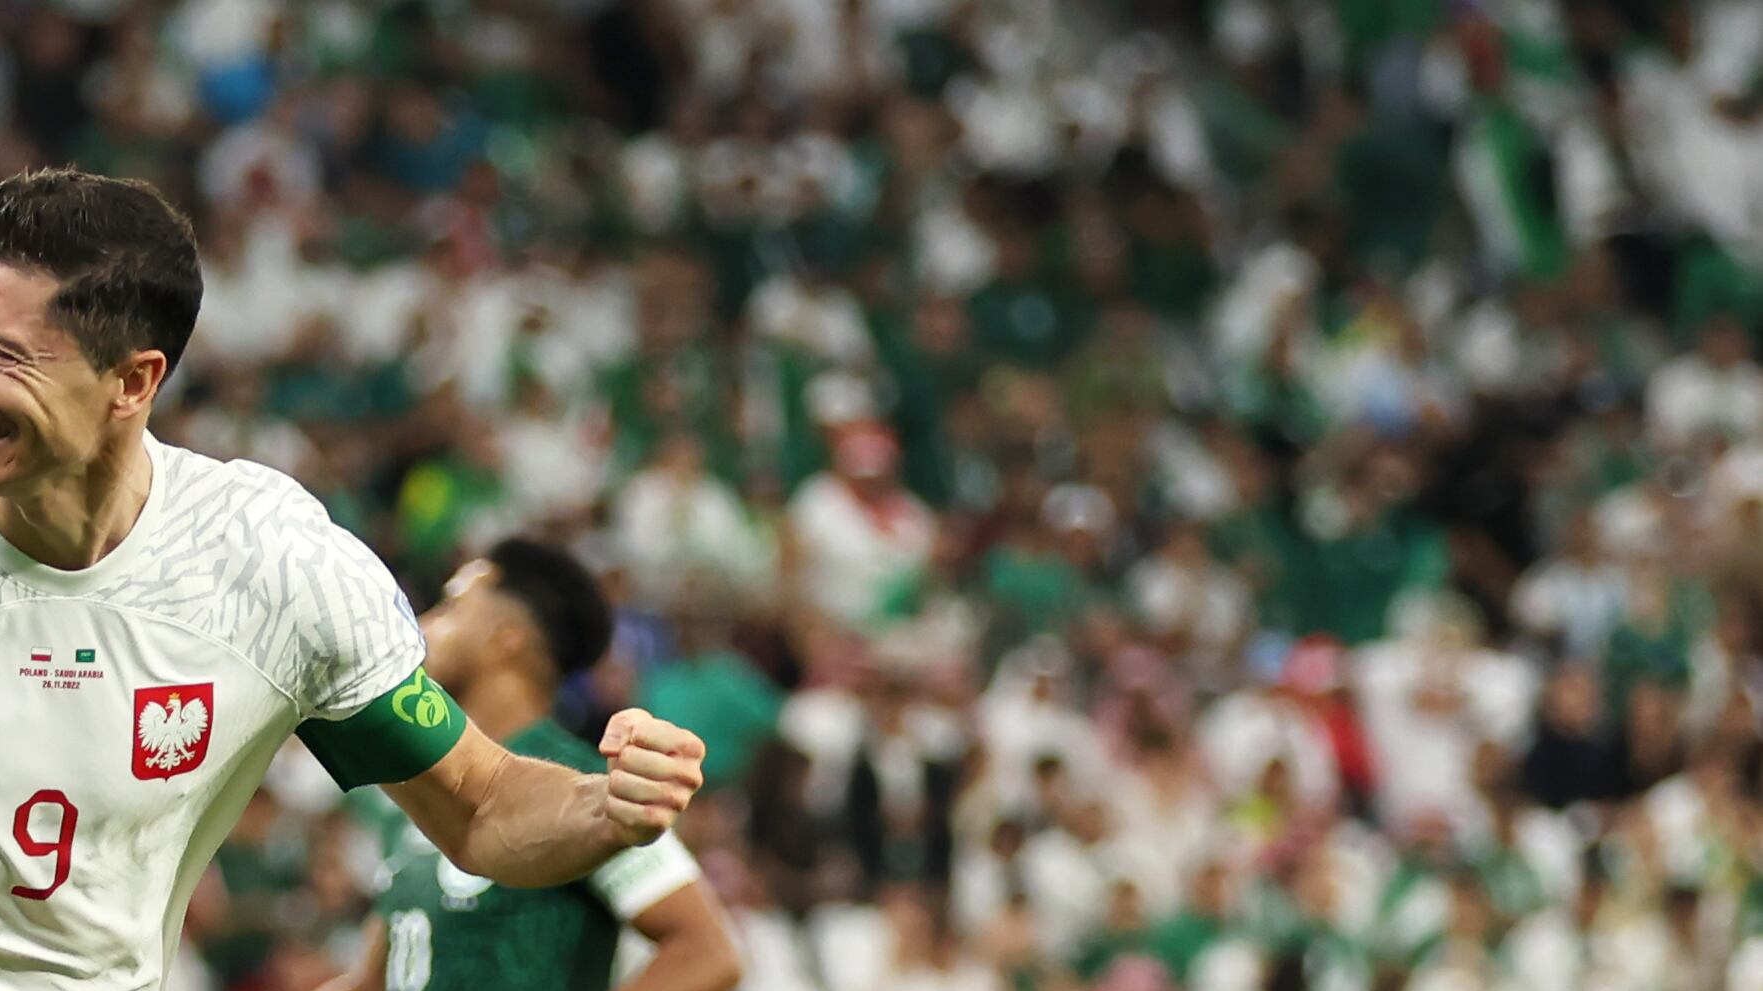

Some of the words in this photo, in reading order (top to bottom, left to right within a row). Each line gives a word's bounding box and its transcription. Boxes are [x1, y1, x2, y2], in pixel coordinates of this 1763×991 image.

[19, 668, 48, 677] POLAND
[54, 669, 77, 678] SAUDI
[78, 670, 104, 679] ARABIA
[42, 680, 80, 690] 26.11.2022
[11, 789, 79, 901] 9
